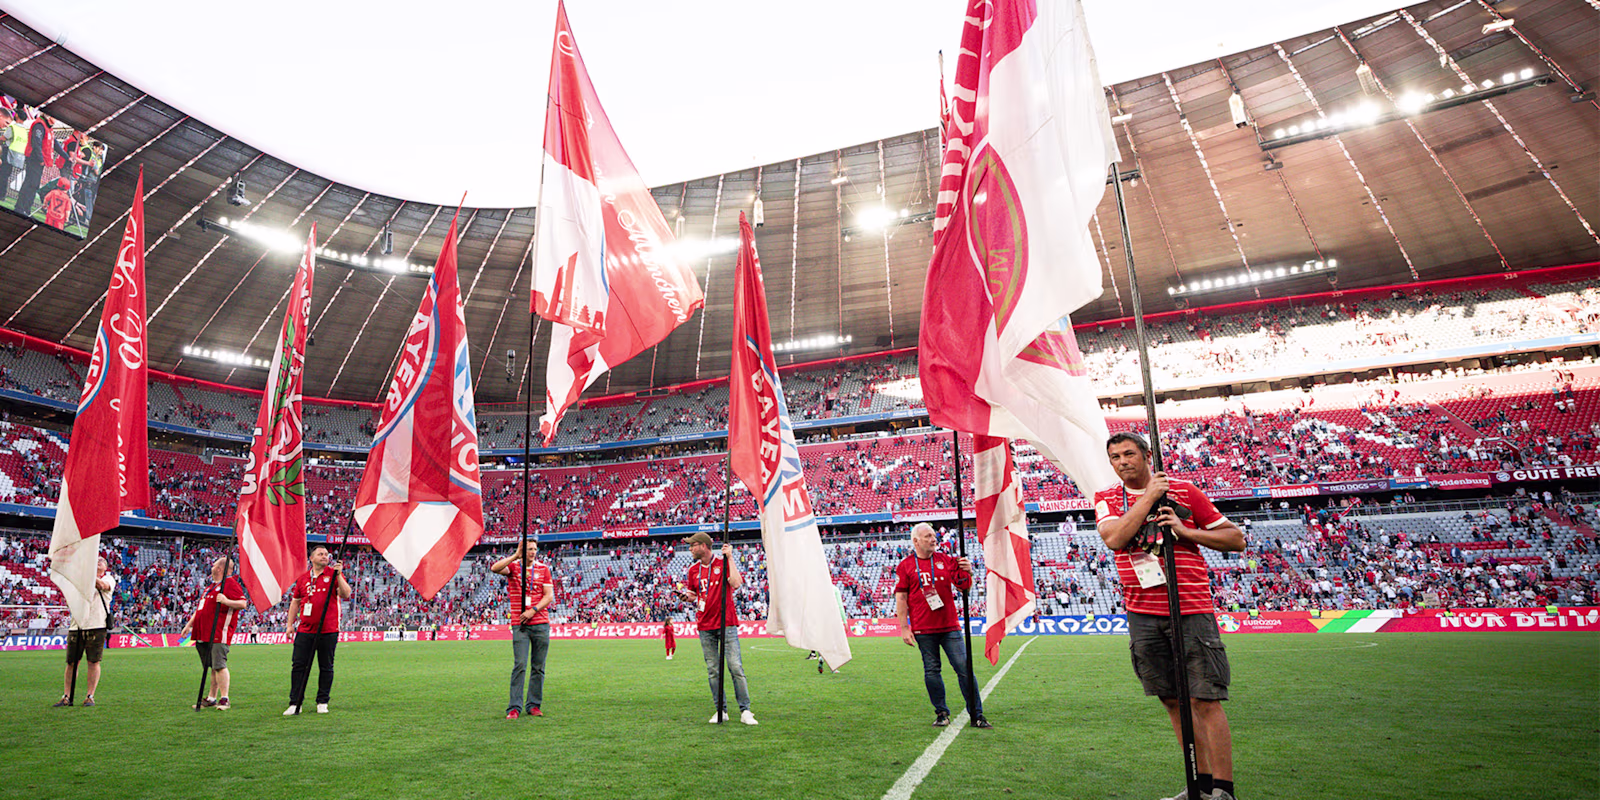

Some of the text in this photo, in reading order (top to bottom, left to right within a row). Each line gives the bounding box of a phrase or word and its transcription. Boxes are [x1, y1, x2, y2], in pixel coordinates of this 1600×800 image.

[1513, 468, 1560, 480] GUTE
[1430, 476, 1489, 487] Waldenburg
[1271, 484, 1319, 498] Riemsloh
[1330, 484, 1346, 492] RED
